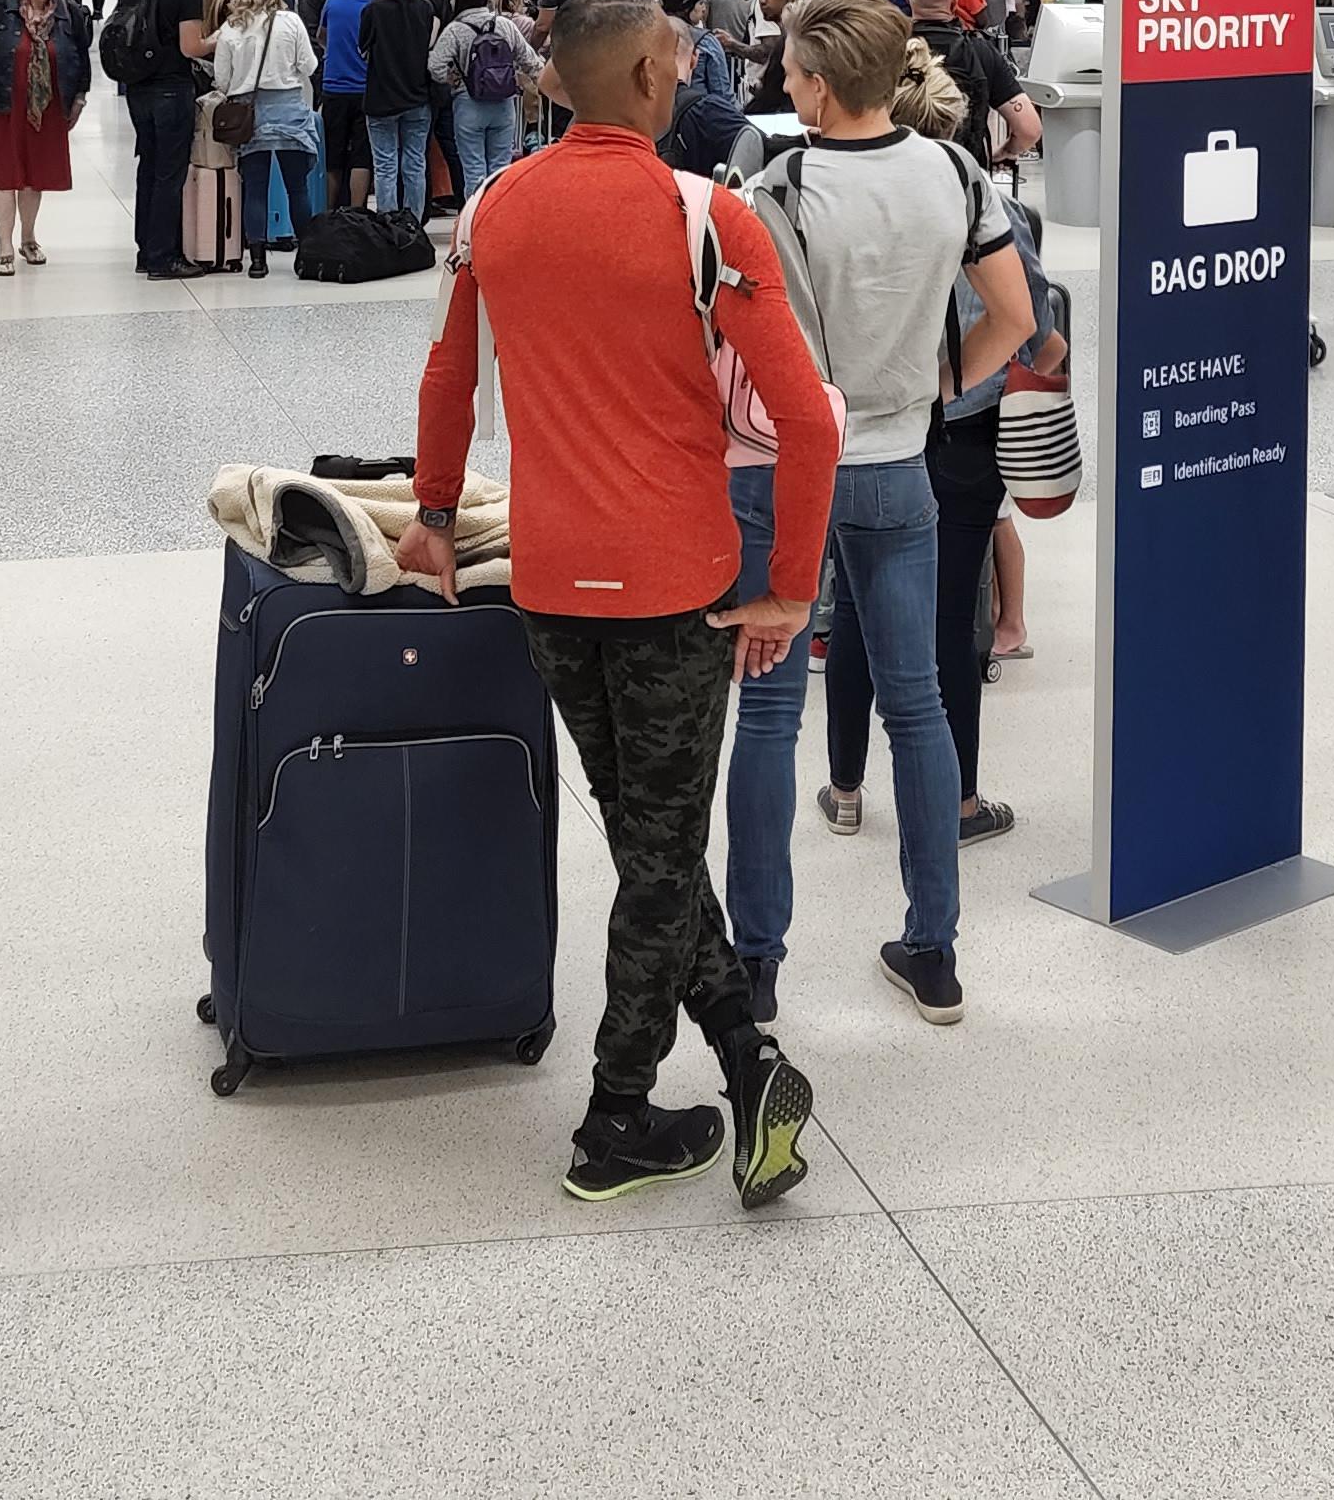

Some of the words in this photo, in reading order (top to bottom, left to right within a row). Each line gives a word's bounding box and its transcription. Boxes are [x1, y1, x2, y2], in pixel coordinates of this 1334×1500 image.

[1138, 13, 1290, 53] PRIORITY
[1151, 255, 1207, 295] BAG
[1214, 246, 1286, 287] DROP
[1143, 361, 1196, 390] PLEASE
[1200, 354, 1245, 380] HAVE:
[1175, 404, 1228, 428] Boarding
[1231, 401, 1256, 420] Pass
[1174, 452, 1251, 481] Identification
[1252, 443, 1286, 465] Ready
